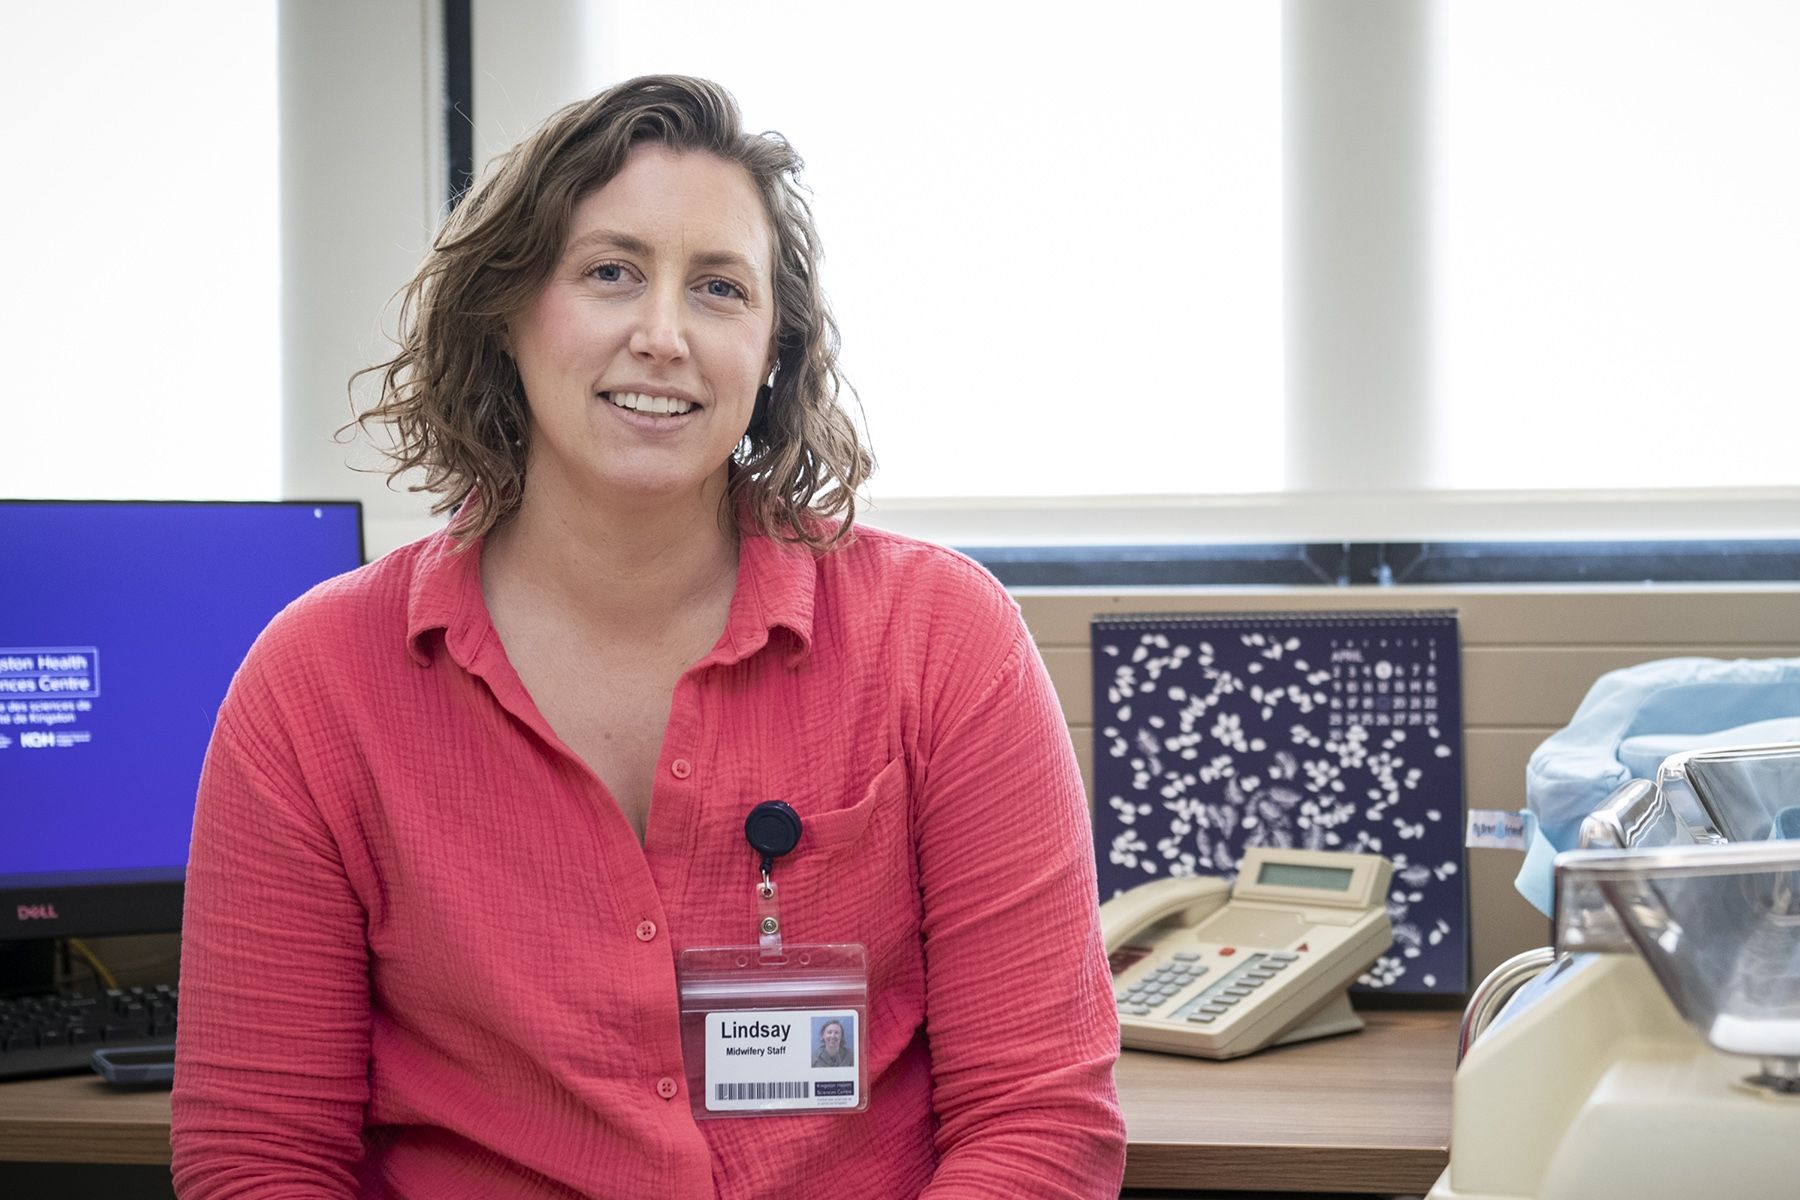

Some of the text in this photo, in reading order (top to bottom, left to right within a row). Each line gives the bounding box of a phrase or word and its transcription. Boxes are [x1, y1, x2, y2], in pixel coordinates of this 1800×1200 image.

[1330, 649, 1363, 663] APRIL
[0, 655, 88, 673] ston Health
[1411, 663, 1421, 677] 7
[38, 675, 90, 692] Centre
[29, 701, 75, 712] sciences
[29, 713, 76, 726] Kingston
[16, 904, 59, 920] DELL
[721, 1020, 791, 1042] Lindsay
[726, 1046, 786, 1057] Midwifery Staff
